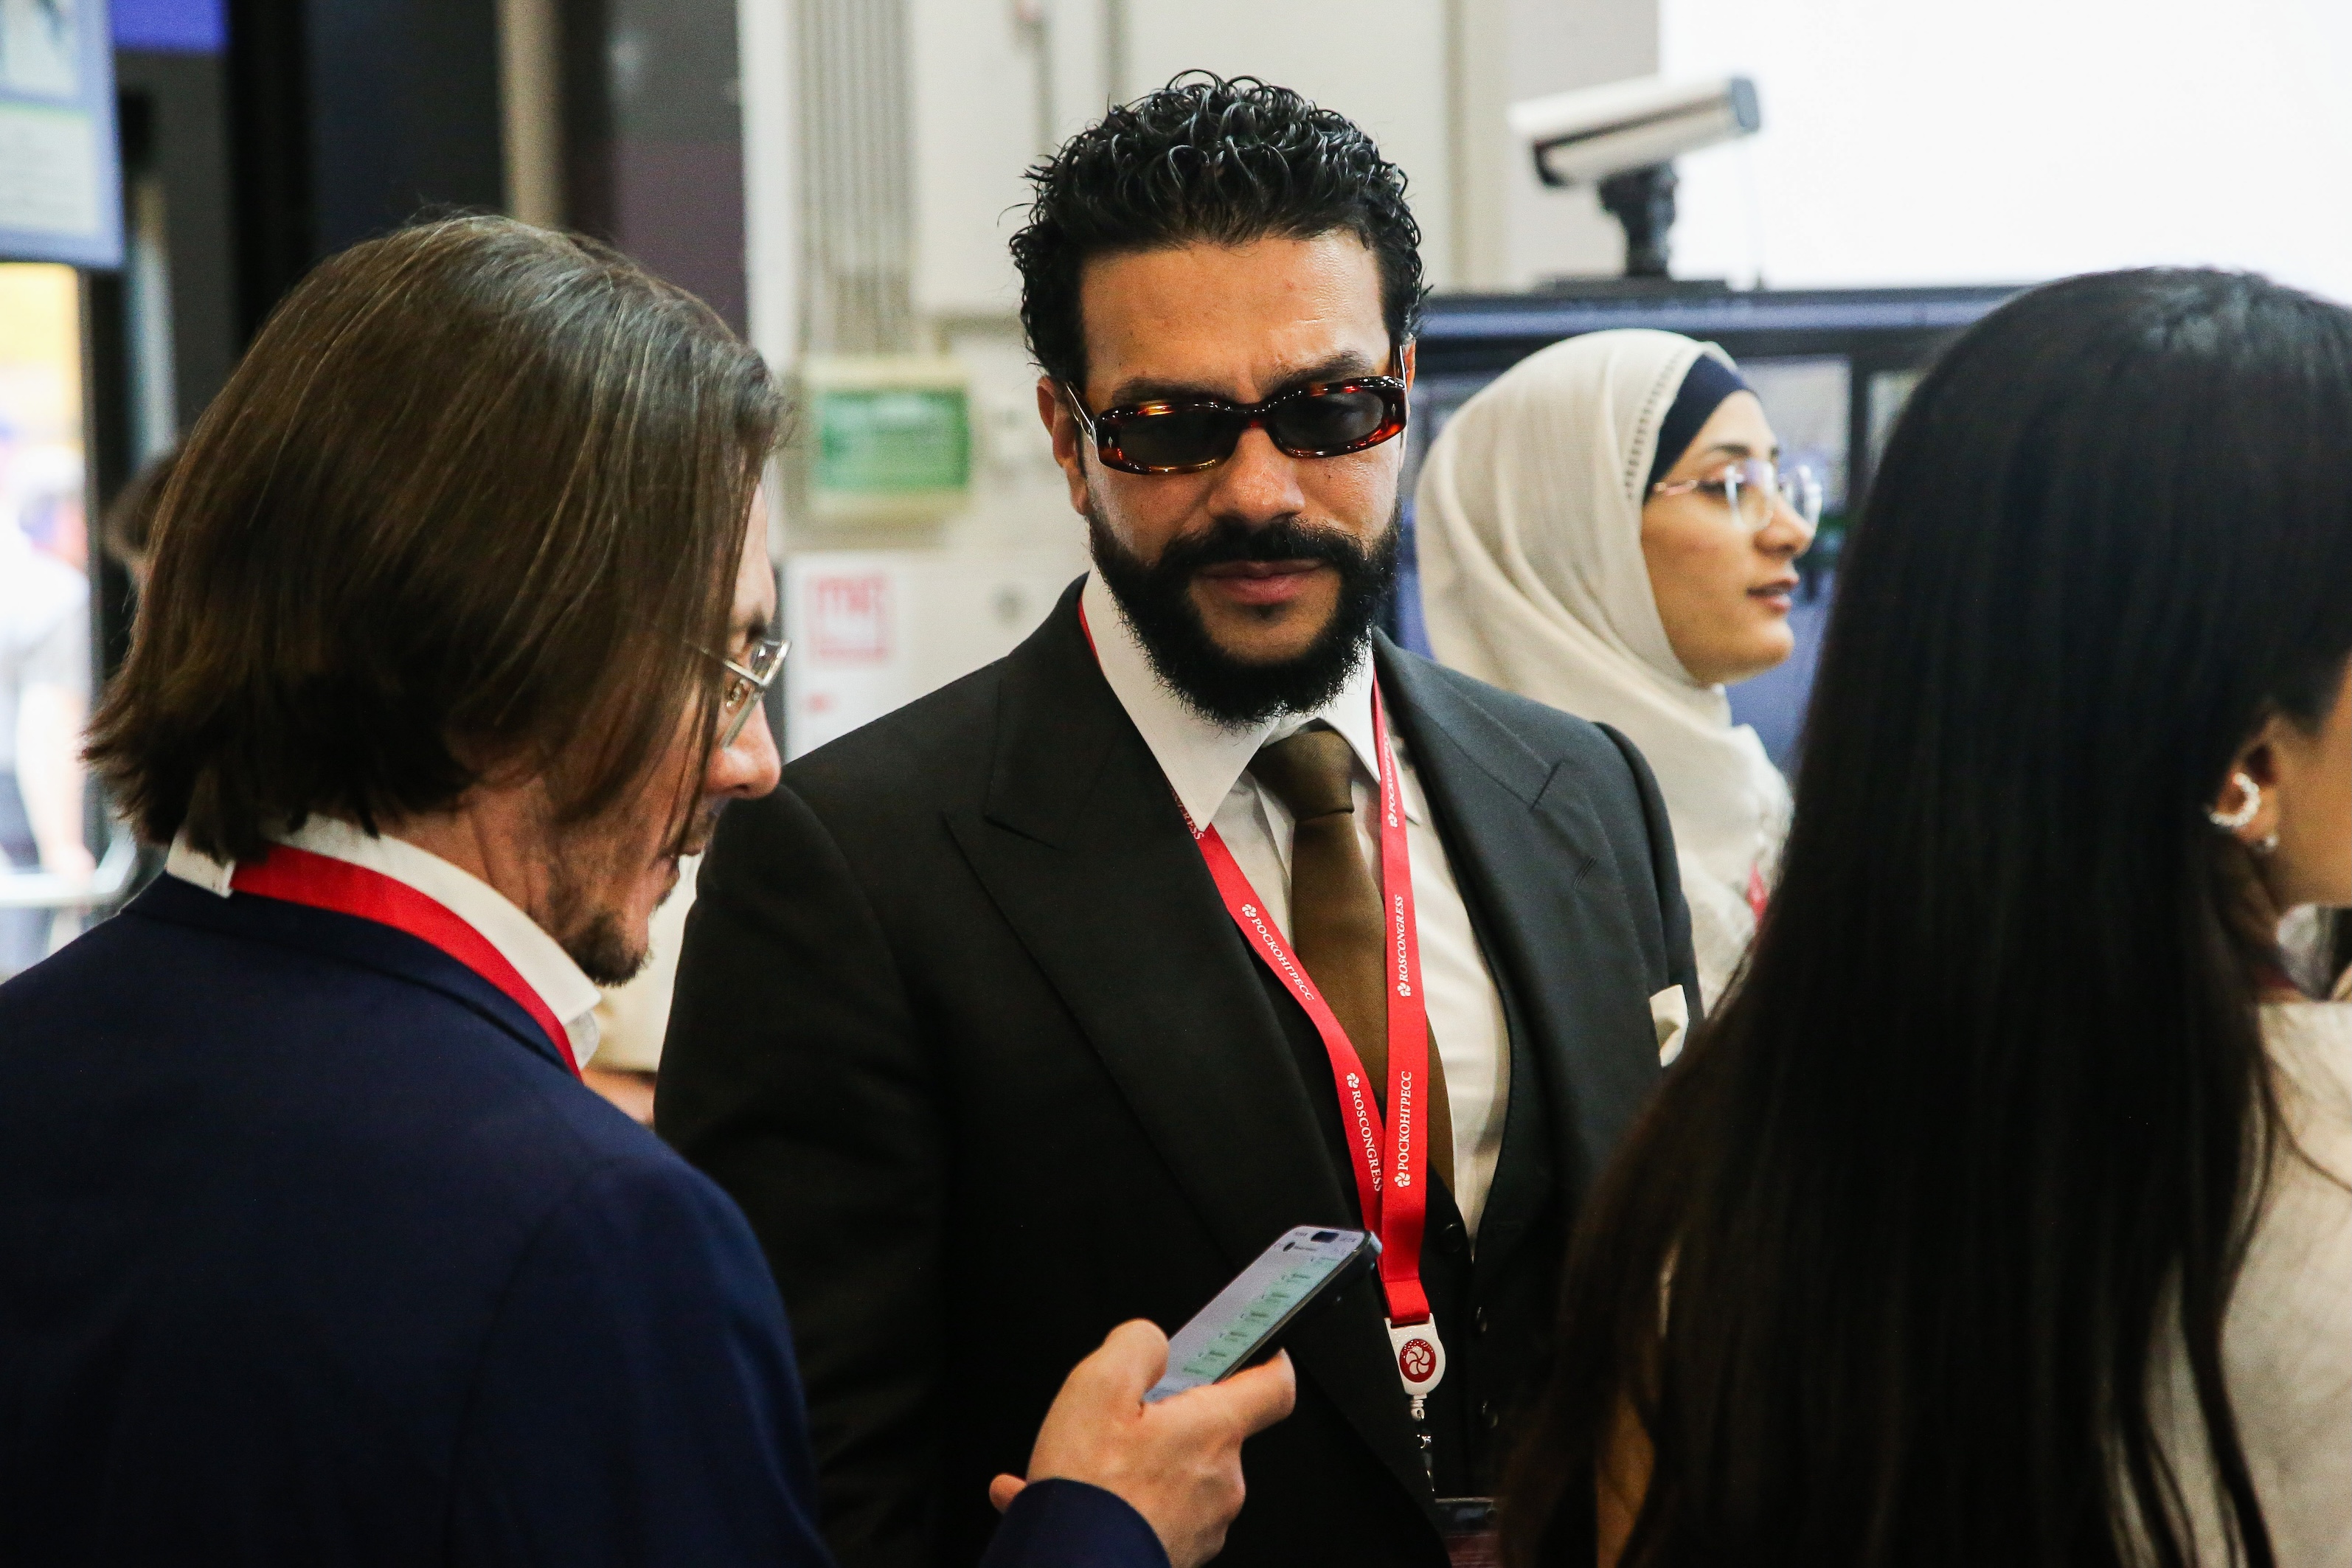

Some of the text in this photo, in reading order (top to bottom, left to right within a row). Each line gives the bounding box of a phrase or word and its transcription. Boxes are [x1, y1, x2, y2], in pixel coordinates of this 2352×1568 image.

[1251, 917, 1314, 1001] РОСКОНГРЕСС
[1395, 894, 1409, 982] ROSCONGRESS
[1351, 1089, 1383, 1192] ROSCONGRESS
[1398, 1071, 1412, 1171] РОСКОНГРЕСС
